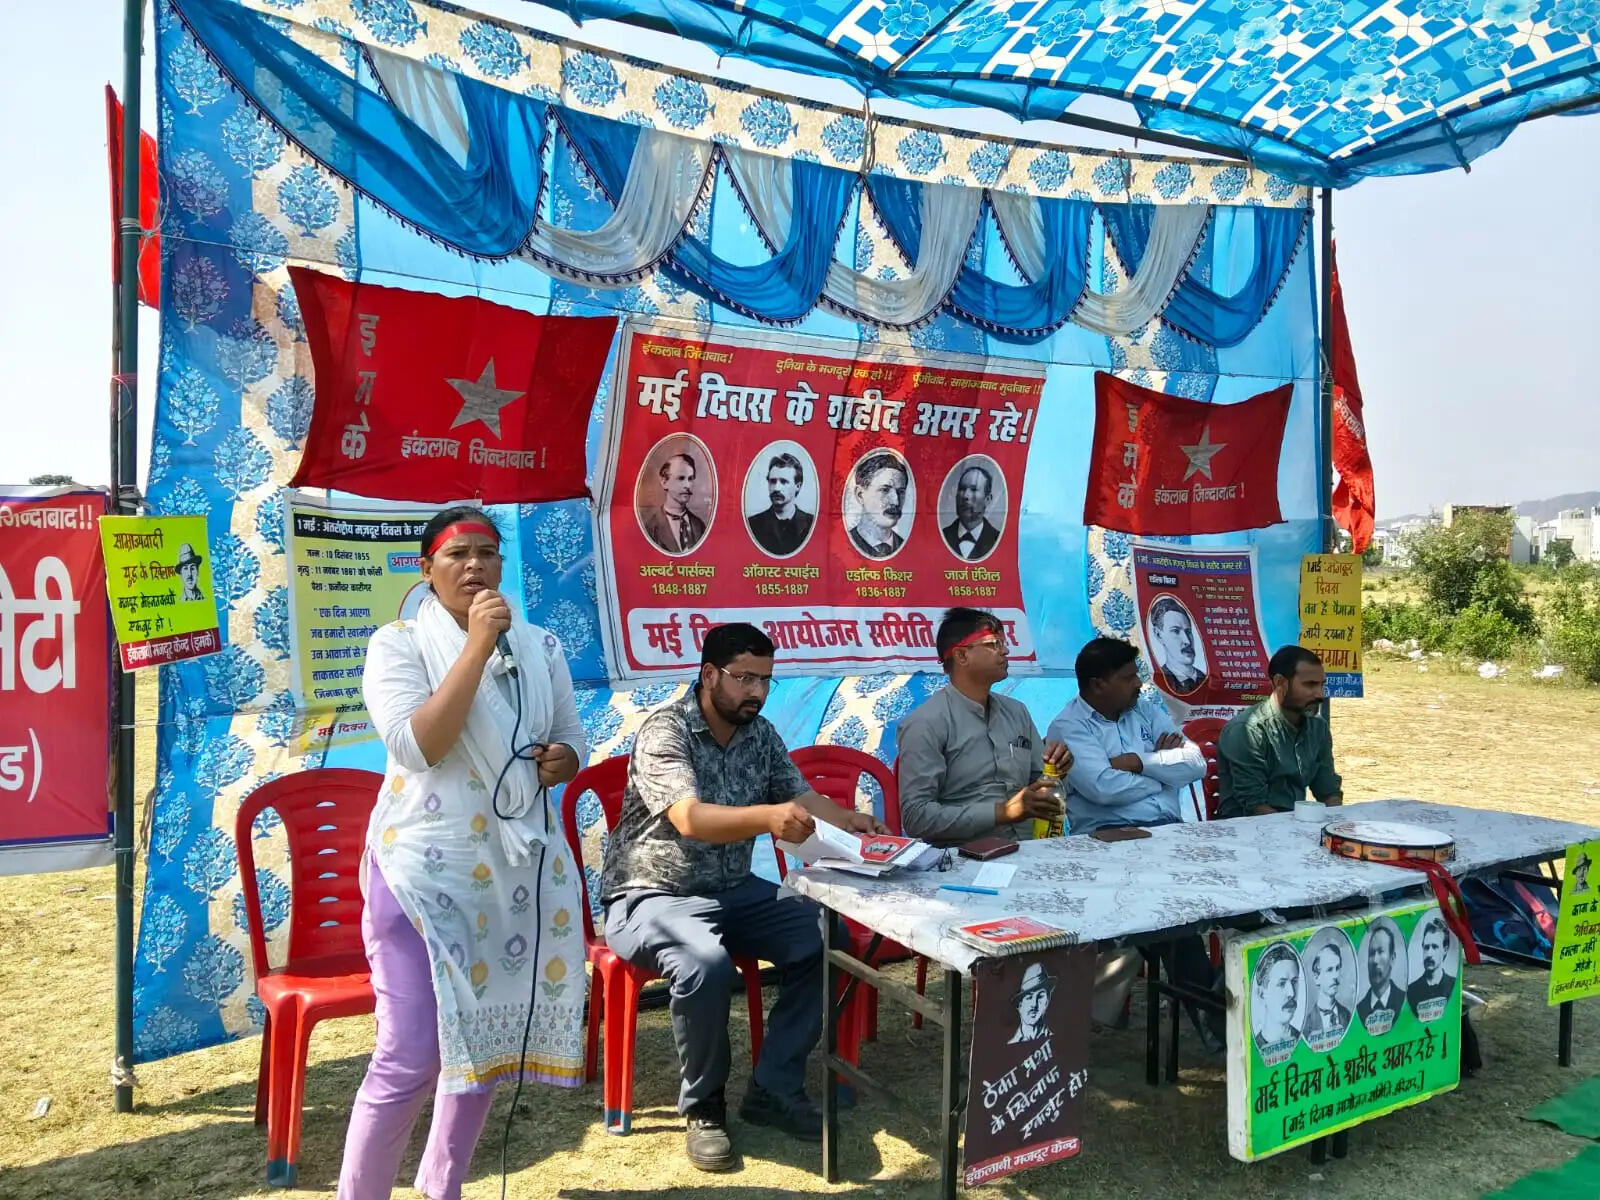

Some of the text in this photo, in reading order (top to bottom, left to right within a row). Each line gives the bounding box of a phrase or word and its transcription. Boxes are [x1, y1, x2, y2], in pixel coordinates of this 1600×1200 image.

[642, 341, 681, 358] इंकलाब
[776, 359, 804, 375] दुनिया
[806, 360, 817, 373] के
[854, 368, 869, 378] एक
[637, 369, 1034, 443] मई दिवस के शहीद अमर रहे!
[401, 430, 461, 459] इंकलाब
[469, 438, 536, 469] जिन्दाबाद
[1153, 484, 1189, 506] इंकलाब
[303, 518, 316, 532] मई
[380, 522, 402, 536] दिवस
[403, 522, 412, 536] के
[354, 552, 370, 560] 1855
[139, 560, 148, 580] के
[676, 561, 715, 578] पार्सन्स
[784, 562, 820, 579] स्पाईस
[883, 566, 913, 582] फिशर
[944, 566, 1001, 582] जार्ज एंजिल
[652, 583, 708, 595] 1848-1887
[755, 583, 809, 595] 1855-1887
[855, 586, 906, 598] 1836-1887
[948, 585, 997, 597] 1858-1887
[1313, 576, 1342, 596] दिवस
[319, 607, 331, 617] एक
[332, 605, 347, 617] दिन
[310, 628, 322, 638] जब
[324, 625, 345, 639] हमारी
[642, 612, 684, 659] मई
[762, 611, 862, 651] आयोजन
[865, 612, 937, 648] समिति
[352, 645, 361, 657] से
[345, 664, 365, 678] साबि
[344, 687, 359, 698] तुम
[982, 1038, 1053, 1109] ठेका प्रथा
[1254, 1070, 1281, 1115] मई
[1284, 1062, 1324, 1106] दिवस
[1326, 1053, 1340, 1091] के
[1343, 1044, 1378, 1085] शहीद
[1382, 1039, 1416, 1070] अमर
[991, 1065, 1060, 1135] के खिलाफ
[1309, 1103, 1334, 1126] दिवस
[965, 1137, 1079, 1186] इंकलाबी मजदूर केन्द्र
